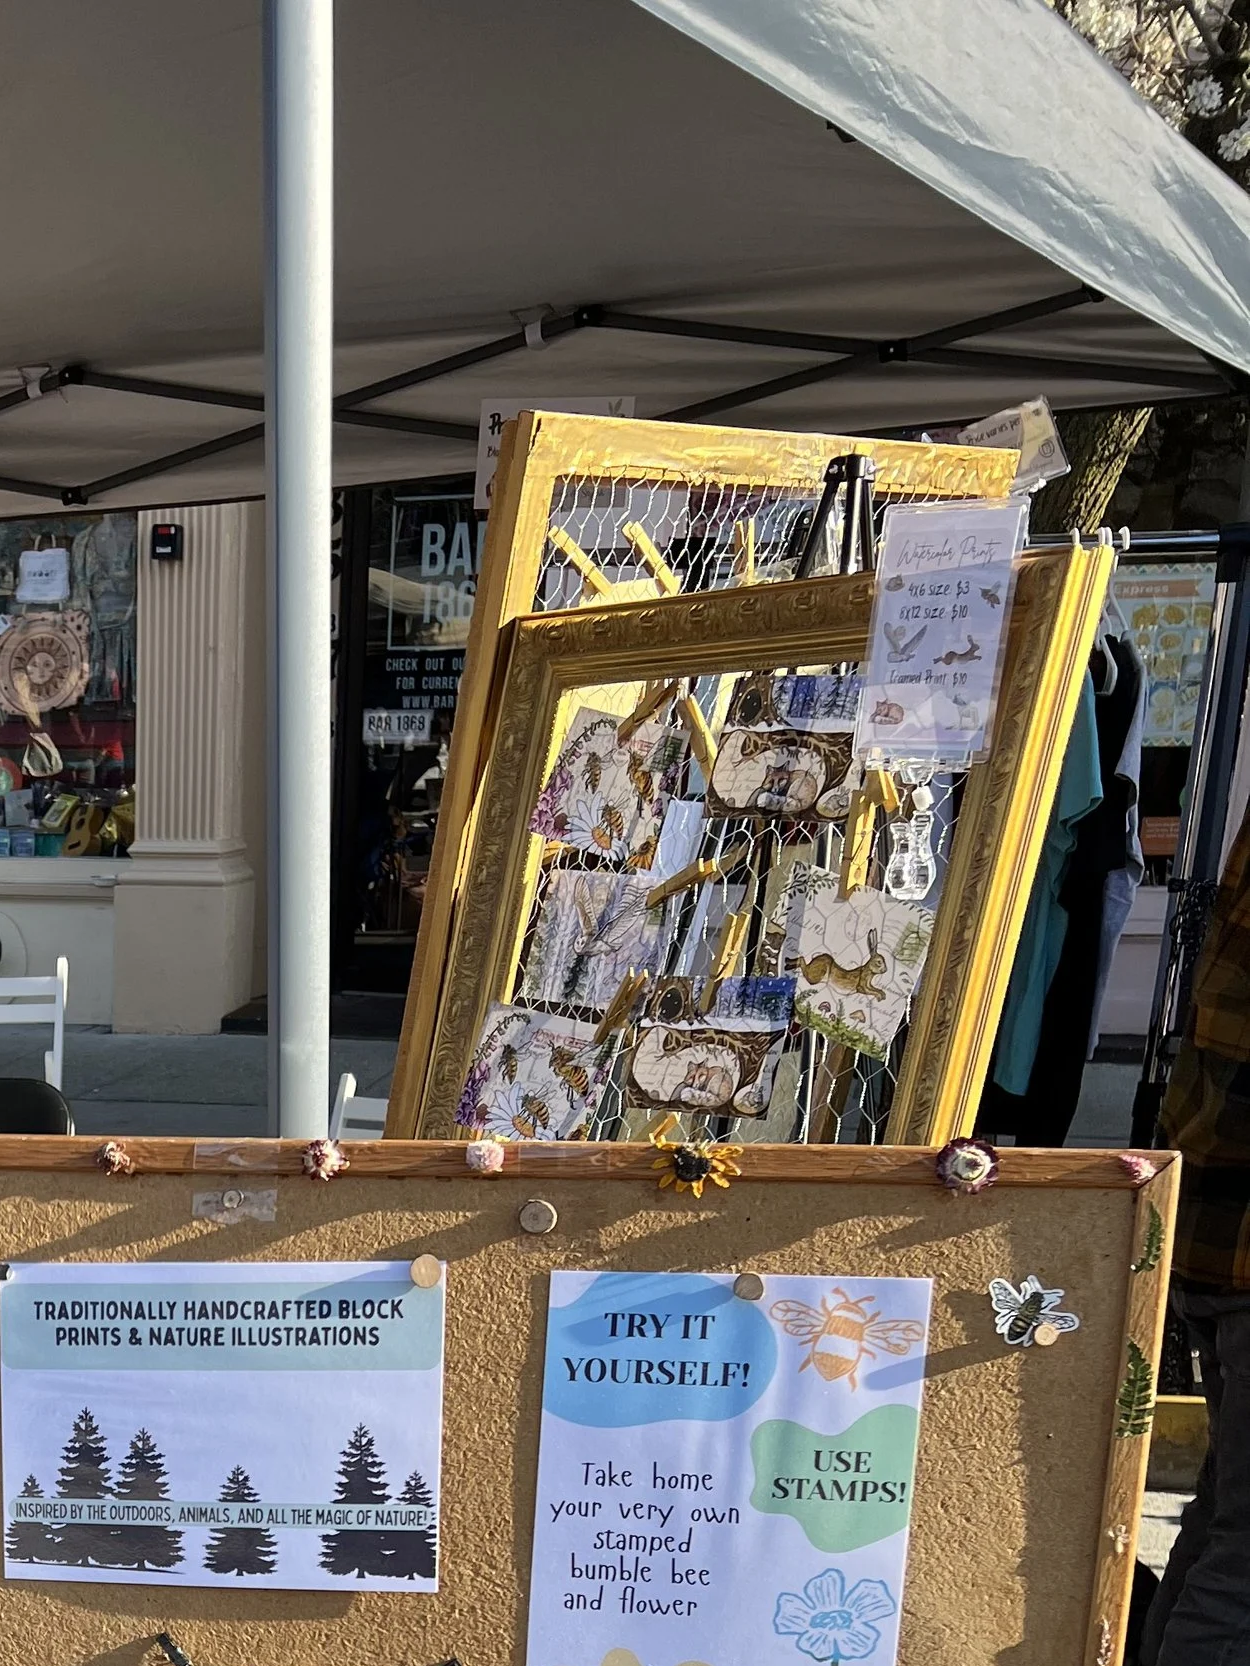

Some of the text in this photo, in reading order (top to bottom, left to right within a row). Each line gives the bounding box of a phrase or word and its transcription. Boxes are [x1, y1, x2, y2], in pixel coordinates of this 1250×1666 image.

[958, 536, 1002, 568] Prints
[956, 580, 970, 596] $3
[1114, 580, 1170, 598] Express
[951, 603, 968, 620] $10
[385, 657, 445, 671] CHECK OUT
[395, 676, 461, 690] FOR CURREN
[953, 671, 968, 687] $10
[368, 715, 392, 731] BAR
[33, 1298, 404, 1321] TRADITIONALLY HANDCRAFTED BLOCK
[55, 1325, 380, 1347] PRINTS & NATURE ILLUSTRATIONS
[604, 1311, 716, 1340] TRY IT
[562, 1356, 751, 1389] YOURSELF!
[812, 1448, 873, 1475] USE
[581, 1461, 714, 1492] Take home
[771, 1476, 907, 1504] STAMPS!
[15, 1503, 429, 1527] INSPIRED BY THE OUTDOORS, ANIMALS, AND ALL THE MAGIC OF NATURE!
[550, 1498, 741, 1528] your very own
[592, 1527, 693, 1557] stamped
[570, 1552, 712, 1587] bumble bee
[563, 1585, 698, 1618] and flower
